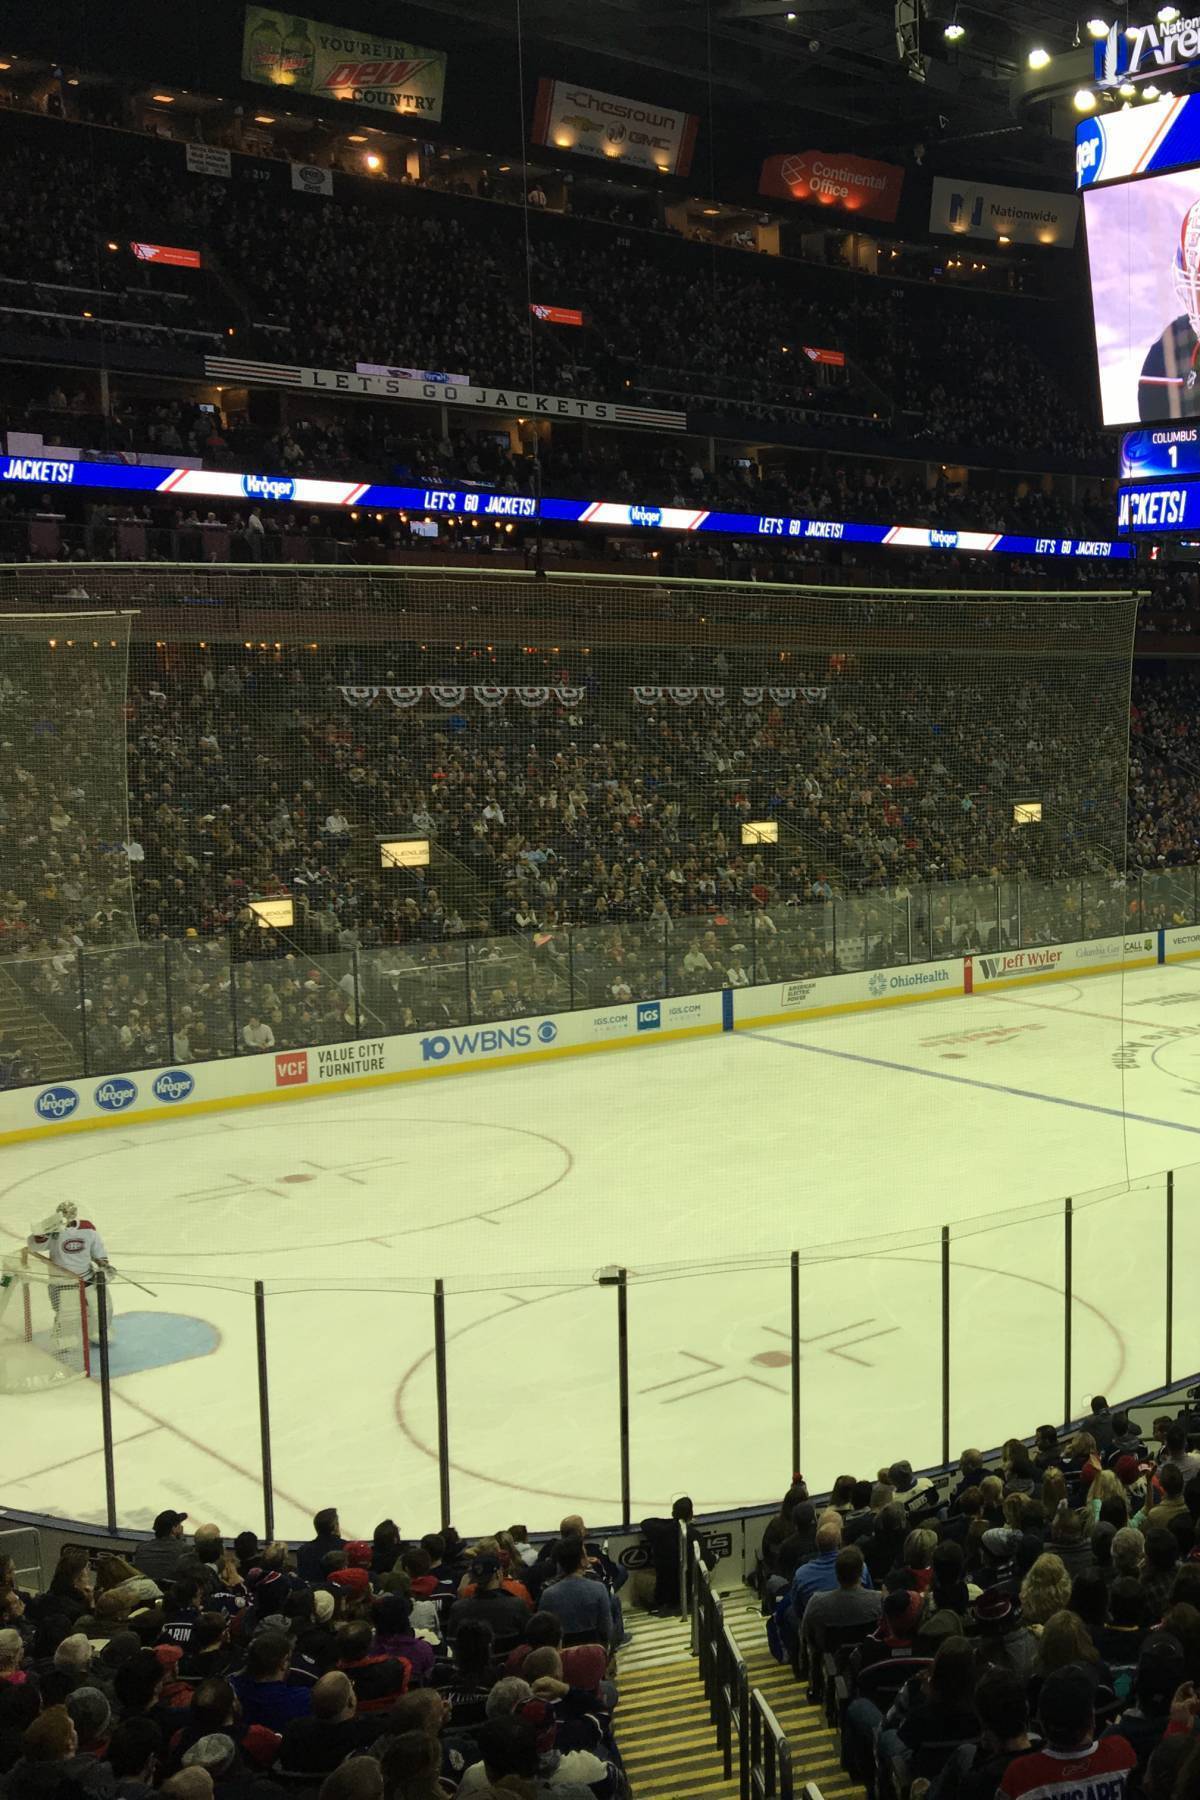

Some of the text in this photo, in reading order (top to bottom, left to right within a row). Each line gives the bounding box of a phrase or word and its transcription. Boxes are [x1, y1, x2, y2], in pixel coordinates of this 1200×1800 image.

[320, 36, 405, 59] YOU'RE IN
[352, 88, 436, 112] COUNTRY
[629, 131, 672, 151] GMC
[811, 161, 888, 191] Continental
[808, 177, 850, 199] Office
[990, 203, 1059, 223] Nationwide
[313, 371, 400, 393] LET'S
[423, 384, 458, 400] GO
[475, 390, 608, 418] JACKETS
[1152, 429, 1198, 444] COLUMBUS
[1168, 445, 1178, 468] 1
[3, 459, 75, 483] JACKETS!
[246, 475, 293, 499] Kroger
[424, 491, 536, 516] LET'S GO JACKETS!
[631, 507, 661, 527] Kroger
[759, 517, 844, 539] LET'S GO JACKETS!
[931, 529, 958, 547] Kroger
[1035, 538, 1112, 556] LET'S GO JACKETS!
[1124, 941, 1142, 951] CALL
[1173, 935, 1200, 945] VECTOR
[1002, 955, 1025, 971] Jeff
[1027, 950, 1063, 967] Wyler
[889, 969, 949, 988] OhioHealth
[594, 1014, 628, 1025] IGS.COM
[639, 1009, 659, 1023] IGS
[668, 1004, 701, 1015] IGS.COM
[317, 1042, 385, 1064] VALUE CITY
[420, 1025, 532, 1061] 10 WBNS
[277, 1060, 306, 1078] VCF
[319, 1056, 385, 1079] FURNITURE
[98, 1083, 136, 1108] Kroger
[157, 1074, 192, 1099] Kroger
[39, 1092, 76, 1116] Kroger
